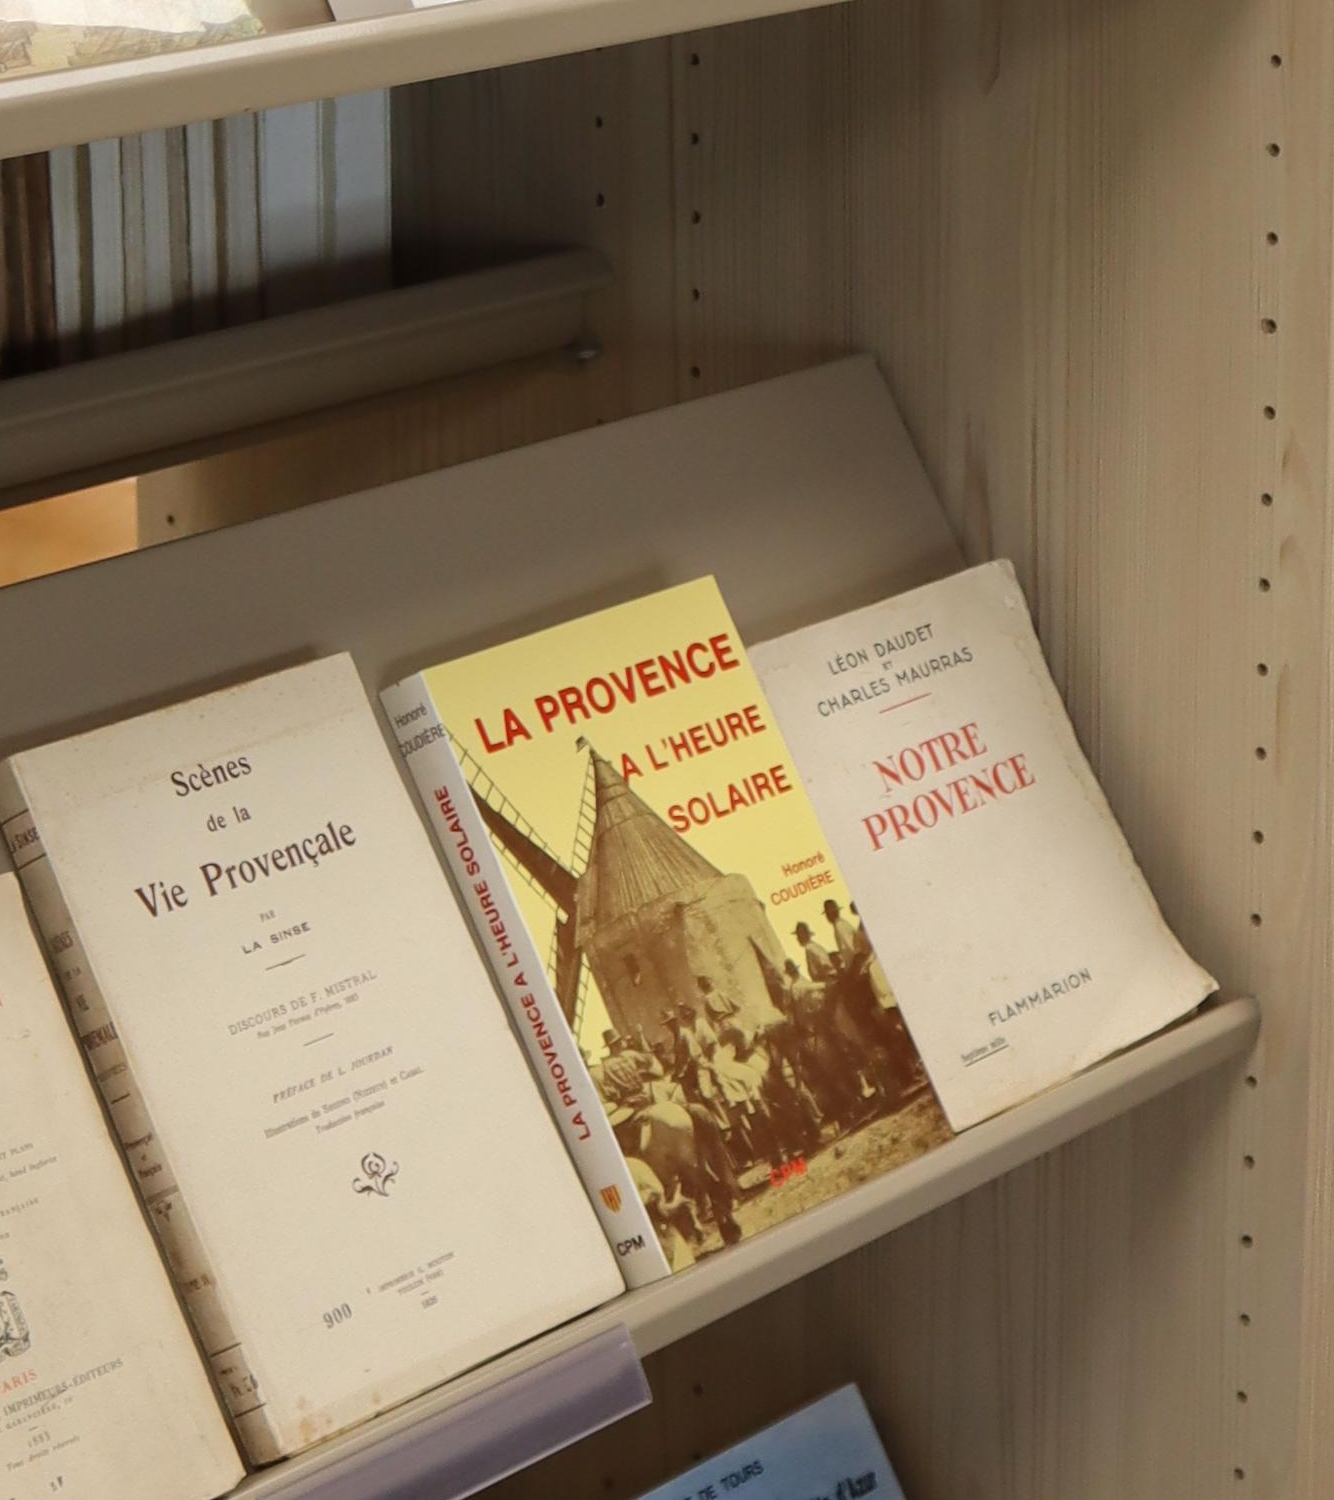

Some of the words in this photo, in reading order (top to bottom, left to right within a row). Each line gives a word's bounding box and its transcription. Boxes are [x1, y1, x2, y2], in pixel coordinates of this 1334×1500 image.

[827, 648, 869, 676] LÉON
[875, 623, 934, 658] DAUDET
[474, 708, 530, 755] LA
[535, 632, 740, 733] PROVENCE
[816, 677, 891, 718] CHARLES
[895, 645, 974, 689] MAURRAS
[619, 751, 644, 783] A
[645, 703, 767, 773] L'HEURE
[873, 722, 989, 793] NOTRE
[169, 753, 253, 797] Scènes
[667, 764, 792, 834] SOLAIRE
[862, 753, 1036, 852] PROVENCE
[206, 809, 228, 834] de
[230, 804, 251, 827] la
[135, 878, 189, 920] Vie
[200, 819, 358, 896] Provençale
[770, 869, 836, 907] COUDIÈRE
[781, 850, 827, 878] Honoré
[241, 939, 263, 955] LA
[270, 921, 312, 944] SINSE
[988, 968, 1093, 1027] FLAMMARION
[323, 1303, 353, 1330] 900
